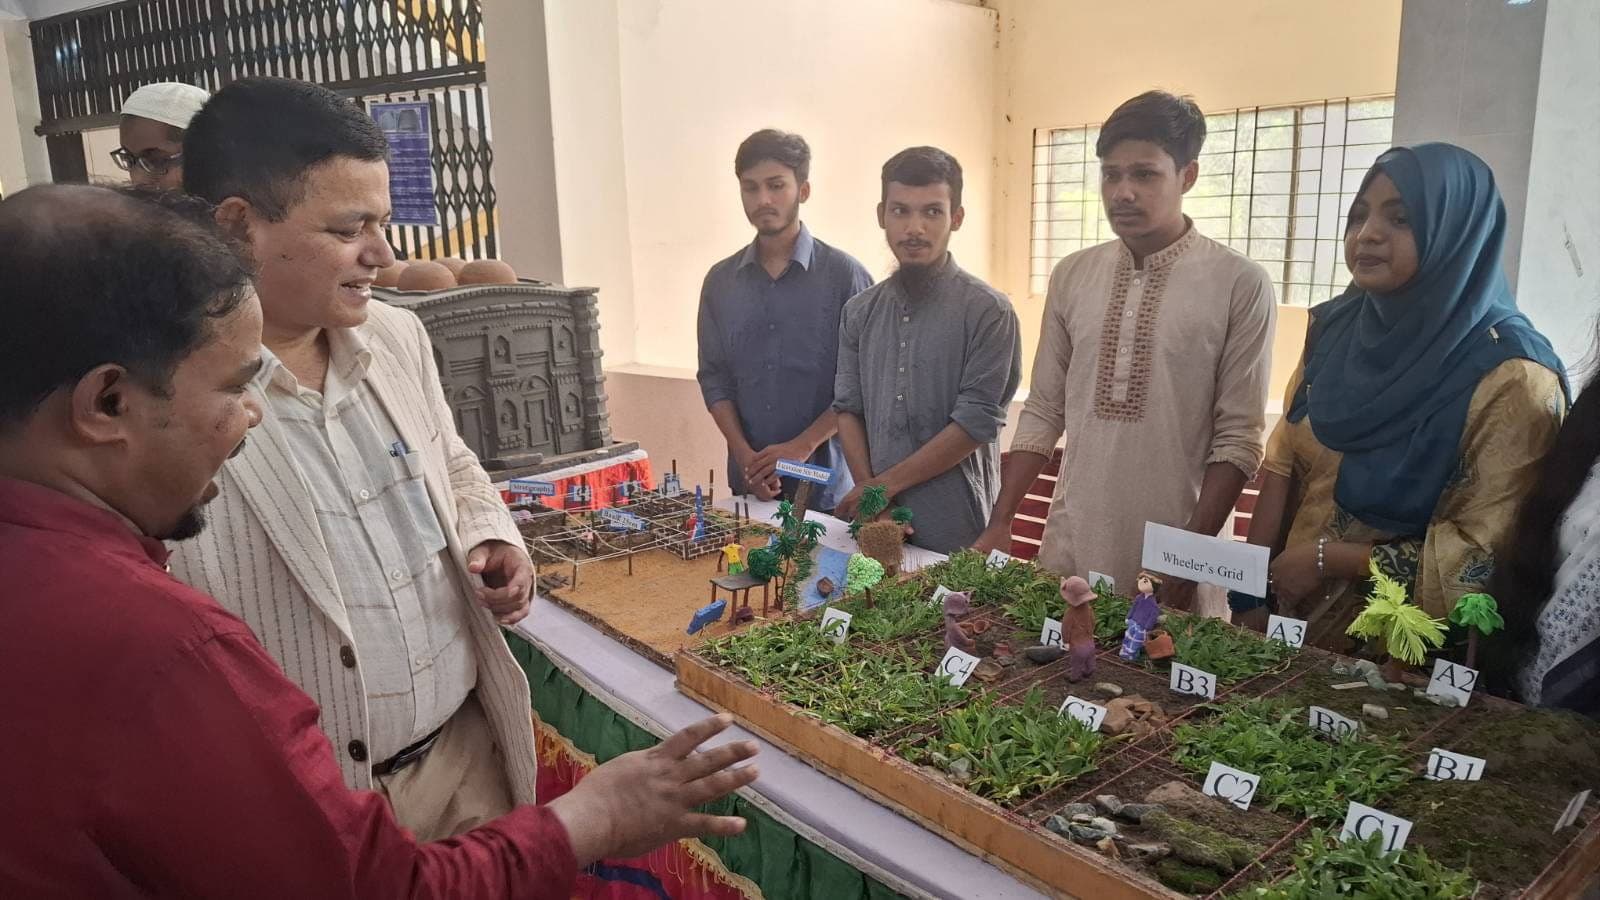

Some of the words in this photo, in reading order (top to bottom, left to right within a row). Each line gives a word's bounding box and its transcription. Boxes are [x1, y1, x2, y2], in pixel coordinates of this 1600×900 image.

[1163, 552, 1214, 575] Wheeler's
[1217, 565, 1244, 581] Grid
[1271, 622, 1303, 645] A3
[945, 655, 973, 678] C4
[1435, 663, 1476, 693] A2
[1176, 668, 1209, 697] B3
[1064, 701, 1097, 728] C3
[1432, 755, 1475, 781] B1
[1213, 773, 1254, 805] C2
[1355, 814, 1400, 852] C1
